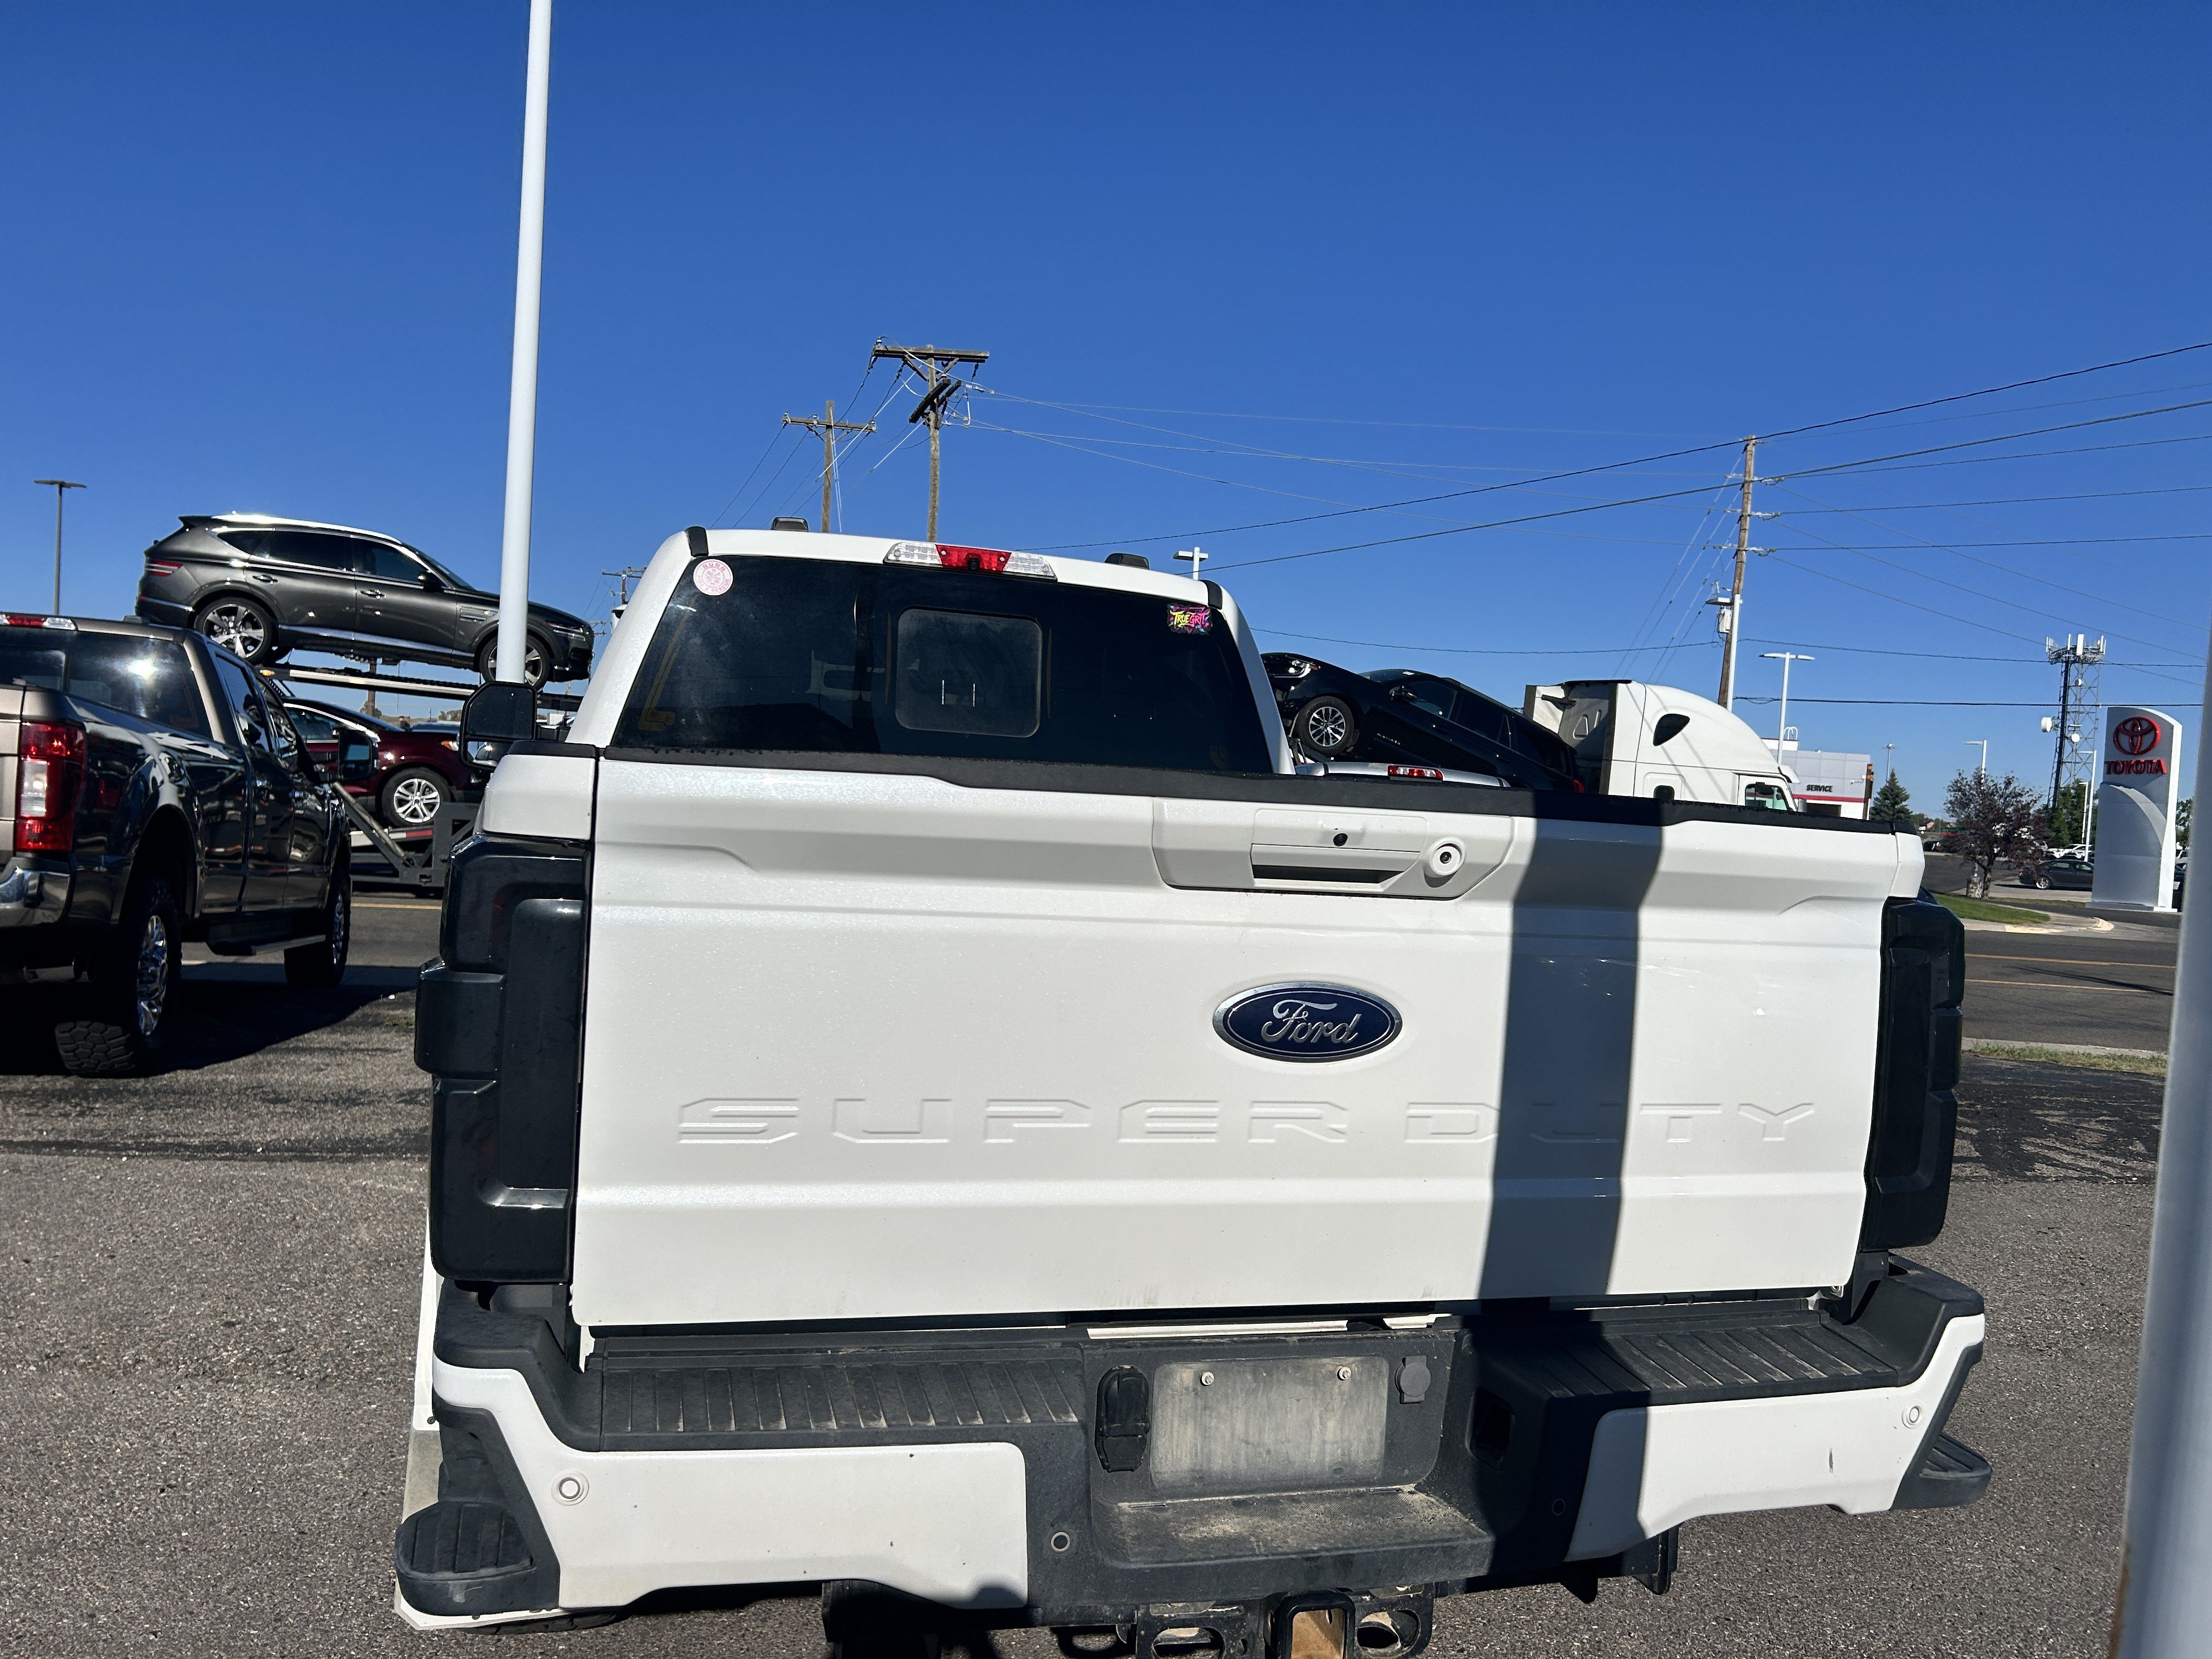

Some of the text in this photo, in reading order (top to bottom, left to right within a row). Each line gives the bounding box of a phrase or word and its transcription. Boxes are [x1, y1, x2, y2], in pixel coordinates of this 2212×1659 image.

[702, 562, 726, 572] NUNN
[711, 578, 730, 592] RESCUE
[1170, 608, 1211, 627] TRUE GRIT
[2104, 759, 2167, 775] TOYOTA
[1806, 785, 1833, 793] SERVICE
[1261, 999, 1362, 1043] Ford
[678, 1098, 1815, 1145] SUPER DUTY
